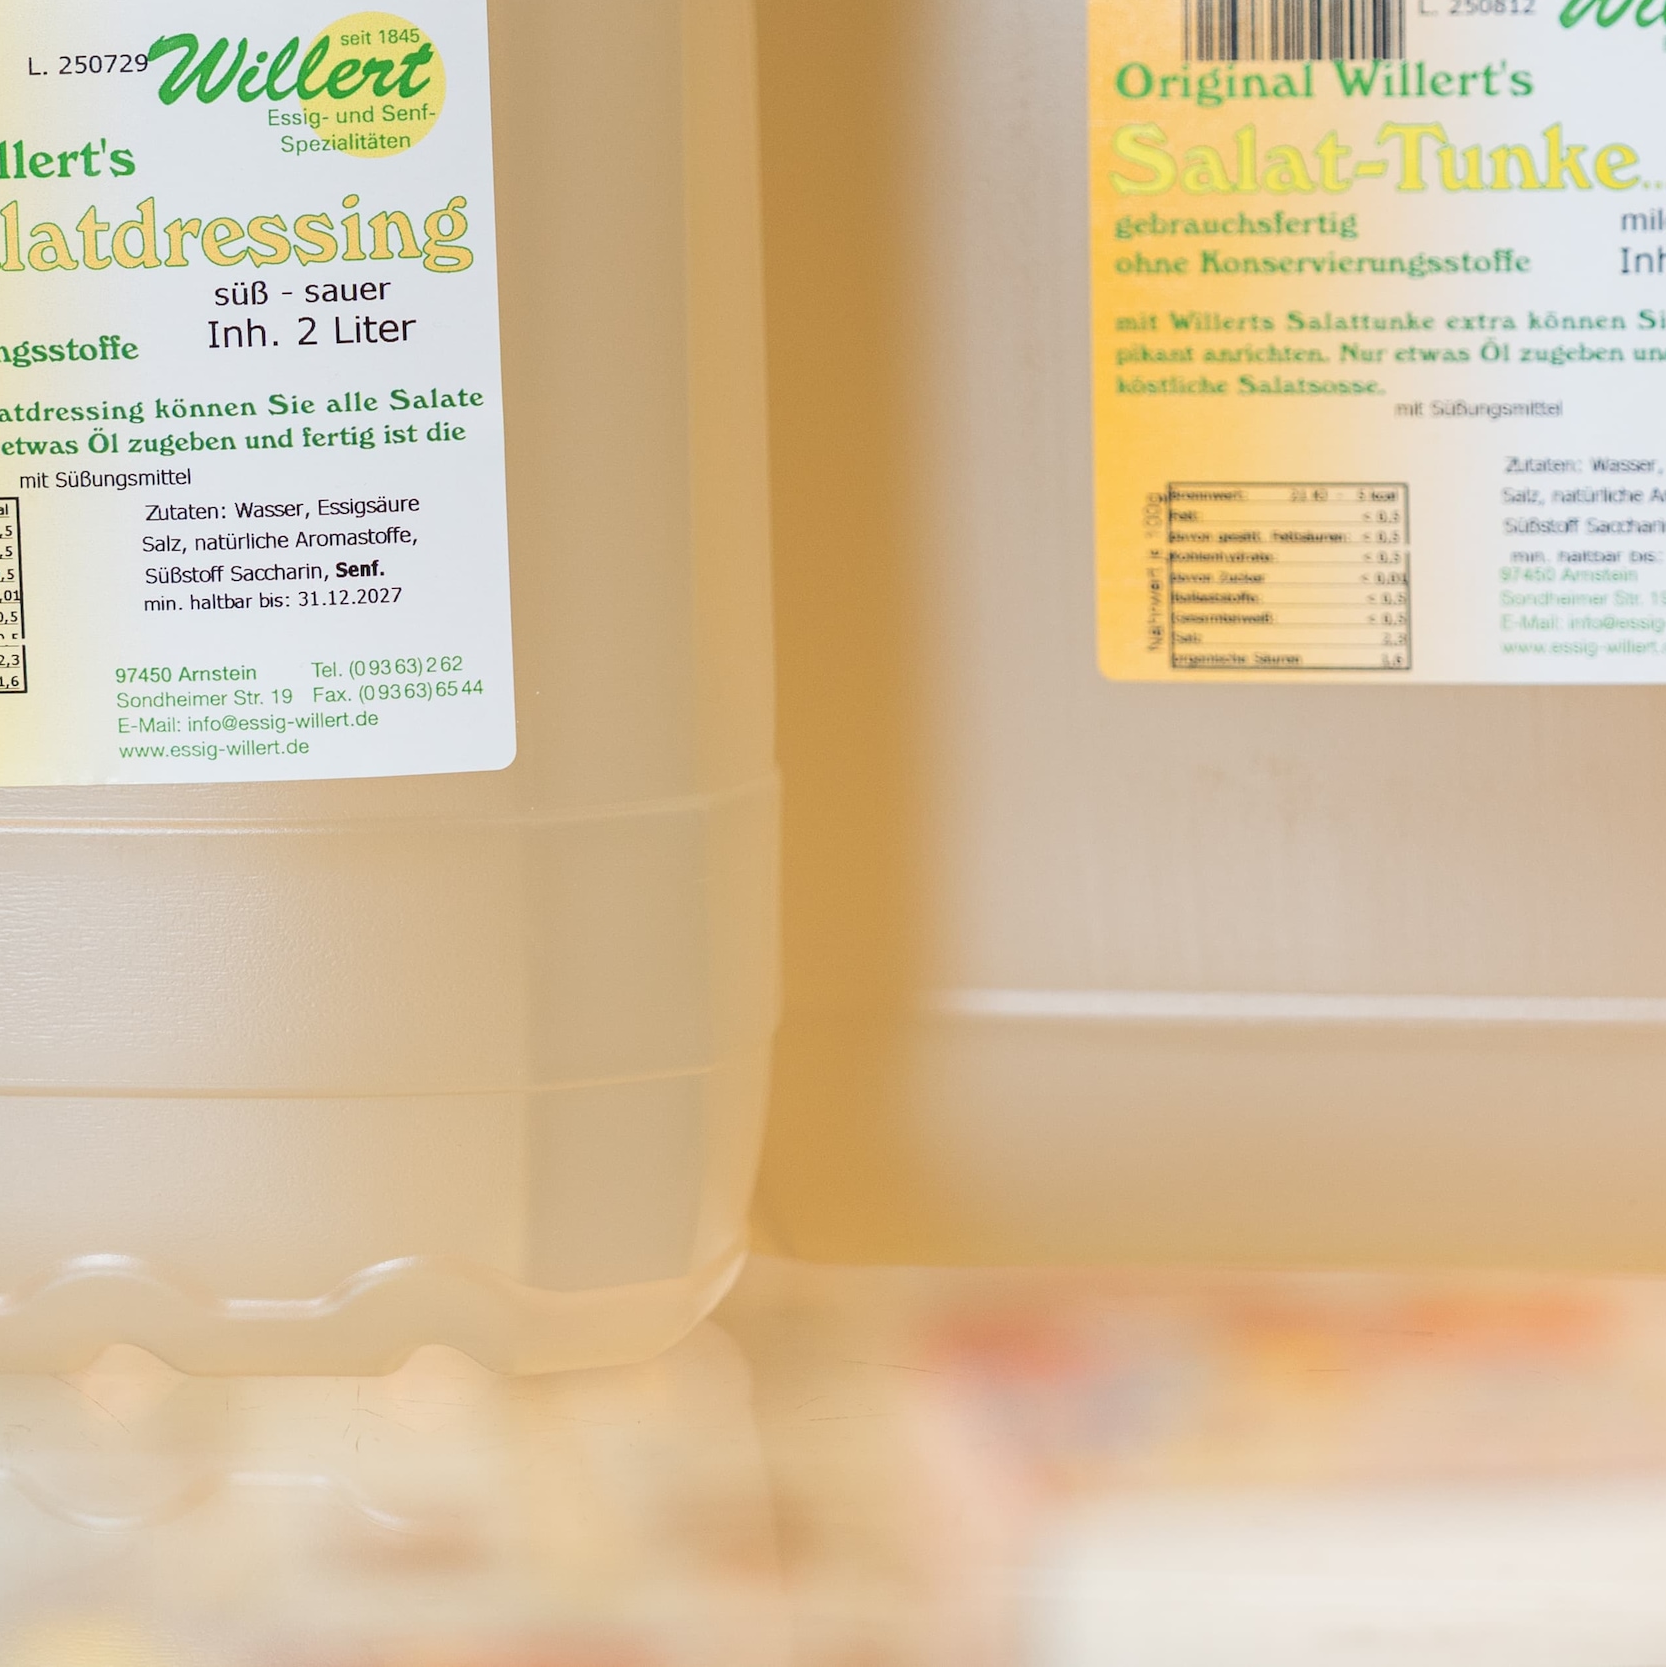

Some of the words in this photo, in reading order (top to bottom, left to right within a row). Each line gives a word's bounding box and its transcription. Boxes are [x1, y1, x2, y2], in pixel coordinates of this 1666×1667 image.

[340, 30, 372, 46] seit
[378, 28, 420, 44] 1845
[28, 57, 48, 76] L.
[59, 54, 148, 75] 250729
[148, 33, 433, 105] Willert
[1115, 60, 1315, 108] Original
[1334, 56, 1534, 98] Willert's
[268, 109, 328, 127] Essig-
[336, 106, 374, 123] und
[383, 105, 436, 123] Senf-
[281, 133, 411, 156] Spezialitäten
[1115, 212, 1358, 239] gebrauchsfertig
[1115, 252, 1188, 276] ohne
[1201, 249, 1530, 278] Konservierungsstoffe
[215, 281, 268, 306] süß
[304, 280, 391, 302] sauer
[208, 319, 279, 349] Inh.
[298, 317, 317, 346] 2
[335, 315, 416, 344] Liter
[1115, 313, 1158, 331] mit
[1169, 312, 1275, 331] Willerts
[1287, 311, 1435, 331] Salattunke
[1447, 313, 1515, 330] extra
[1529, 311, 1626, 329] können
[1115, 346, 1194, 367] pikant
[1203, 344, 1329, 363] anrichten.
[1340, 343, 1386, 363] Nur
[1395, 344, 1470, 363] etwas
[1480, 337, 1510, 363] Öl
[1519, 342, 1624, 366] zugeben
[1115, 377, 1227, 396] köstliche
[155, 399, 257, 419] können
[268, 394, 315, 415] Sie
[326, 392, 378, 413] alle
[389, 388, 484, 410] Salate
[1395, 401, 1423, 417] mit
[2, 436, 78, 455] etwas
[88, 428, 118, 454] Öl
[128, 434, 236, 456] zugeben
[246, 429, 293, 449] und
[302, 427, 376, 450] fertig
[384, 423, 417, 445] ist
[426, 422, 466, 442] die
[19, 473, 48, 489] mit
[55, 468, 191, 490] Süßungsmittel
[145, 502, 226, 522] Zutaten:
[235, 502, 309, 520] Wasser,
[318, 496, 420, 517] Essigsäure
[143, 535, 186, 553] Salz,
[195, 533, 288, 551] natürliche
[296, 528, 417, 548] Aromastoffe,
[145, 566, 223, 585] Süßstoff
[231, 564, 328, 583] Saccharin,
[336, 560, 385, 578] Senf.
[144, 596, 183, 612] min.
[190, 594, 252, 610] haltbar
[260, 591, 290, 608] bis:
[298, 587, 402, 607] 31.12.2027
[115, 667, 172, 684] 97450
[178, 665, 256, 682] Arnstein
[311, 662, 342, 678] Tel.
[117, 691, 227, 709] Sondheimer
[234, 689, 263, 706] Str.
[272, 688, 293, 705] 19
[313, 687, 352, 703] Fax.
[118, 716, 181, 733] E-Mail:
[188, 711, 379, 733] info@essig-willert.de
[119, 740, 309, 760] www.essig-willert.de
